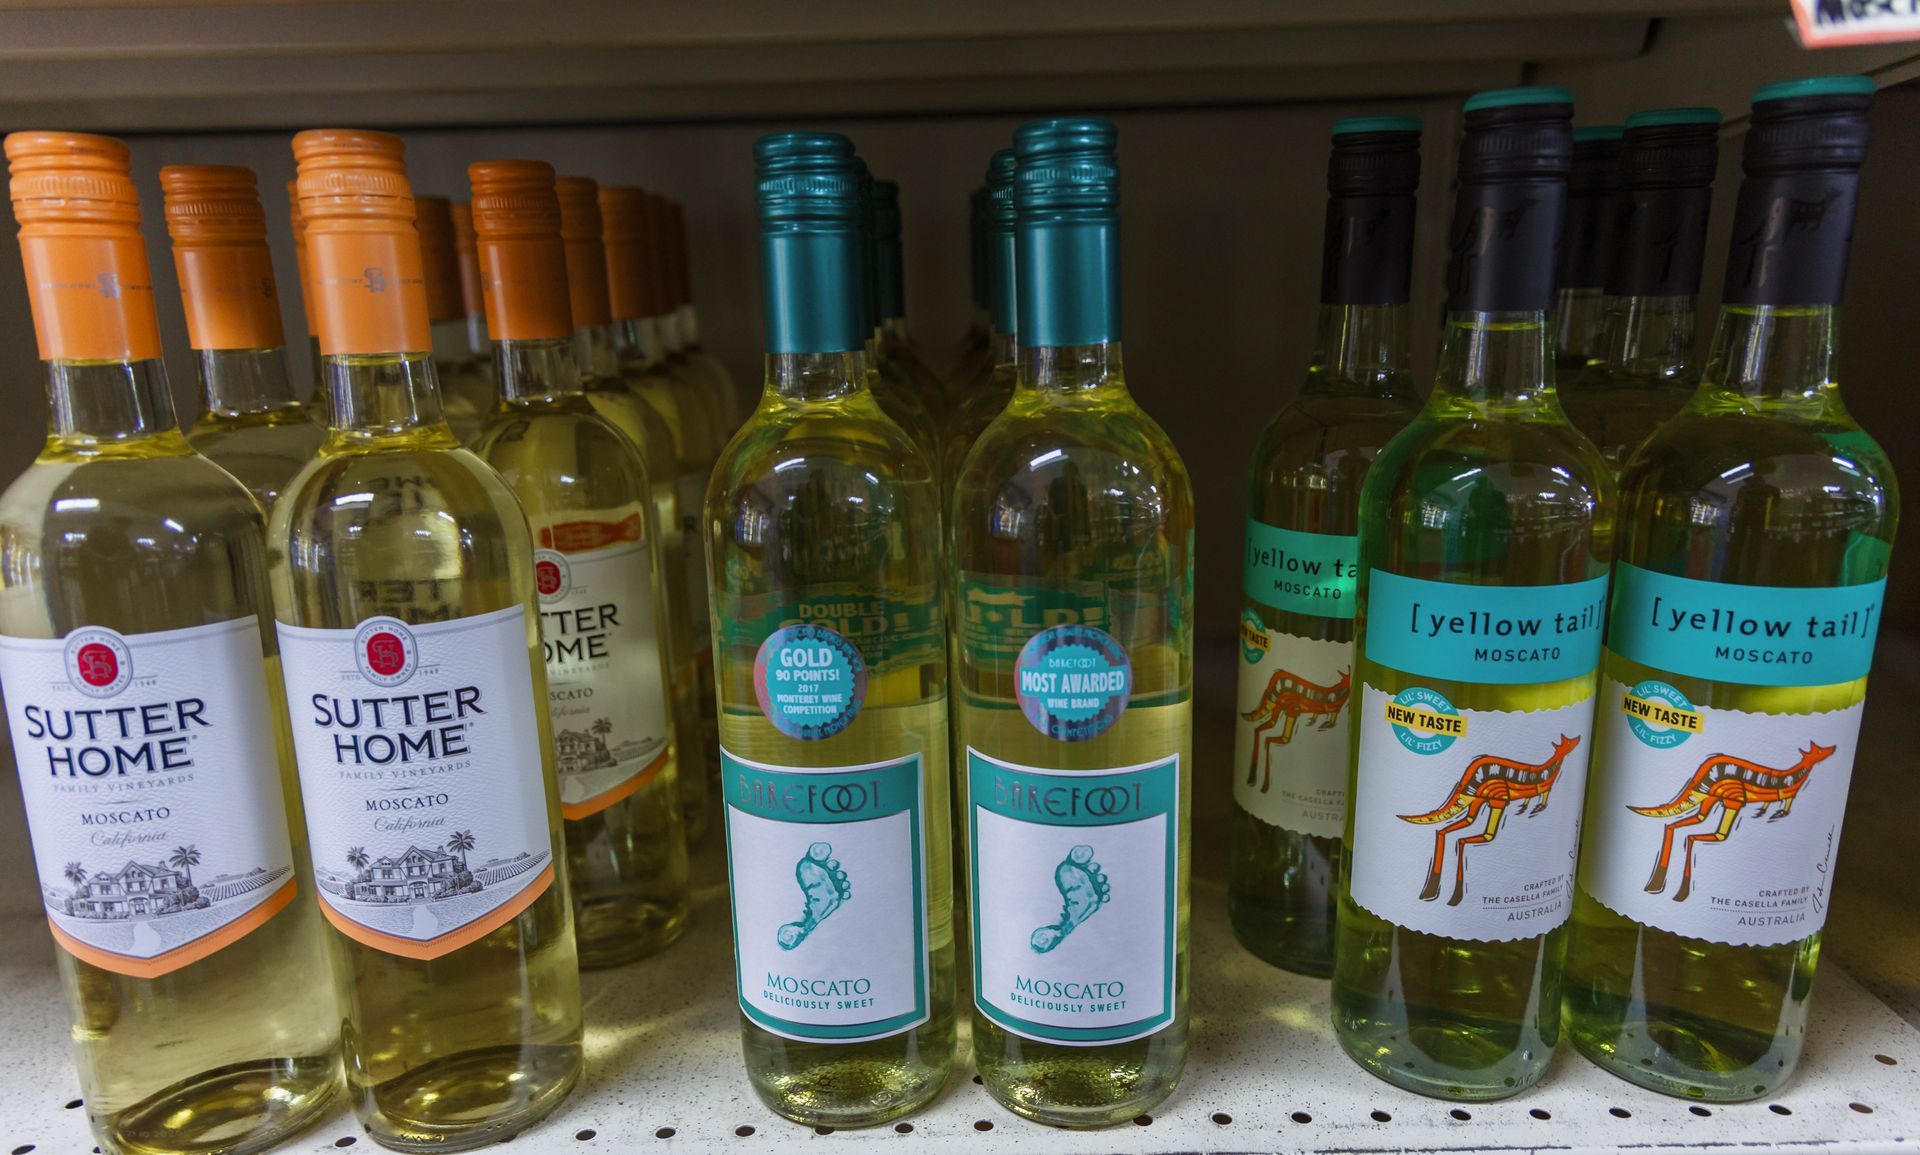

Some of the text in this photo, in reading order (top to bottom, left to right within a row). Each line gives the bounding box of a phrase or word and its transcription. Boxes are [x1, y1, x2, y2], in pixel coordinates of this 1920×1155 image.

[1273, 579, 1342, 600] MOSCATO
[780, 648, 833, 667] GOLD
[1474, 647, 1561, 663] MOSCATO
[1715, 646, 1813, 665] MOSCATO
[775, 669, 840, 681] 90 POINTS!
[1021, 670, 1124, 693] MOST AWARDED
[550, 688, 594, 701] SCATO
[777, 693, 843, 703] MONTEREY WINE
[798, 684, 819, 693] 2017
[1653, 685, 1688, 707] SWEET
[312, 686, 488, 729] SUTTER
[783, 705, 837, 715] COMPETITION
[1047, 698, 1101, 708] WINE BRAND
[1417, 691, 1452, 712] SWEET
[24, 698, 213, 741] SUTTER
[1387, 706, 1462, 733] NEW TASTE
[1624, 697, 1698, 729] NEW TASTE
[1416, 739, 1443, 751] FIZZY
[1650, 733, 1677, 745] FIZZY
[339, 760, 471, 781] FAMILY VINEYARDS
[108, 773, 196, 793] VINEYARDS
[365, 793, 450, 813] MOSCATO
[738, 774, 881, 815] BAREFOOT
[994, 775, 1144, 817] BAREFOOT
[81, 806, 171, 827] MOSCATO
[373, 815, 446, 834] California
[90, 829, 169, 848] California
[1482, 885, 1563, 904] THE CASELLA FAMILY
[1523, 877, 1557, 892] CRAFTED
[1758, 886, 1810, 898] CRAFTED BY
[1507, 901, 1562, 921] AUSTRALIA
[1710, 896, 1808, 908] THE CASELLA FAMILY
[1737, 912, 1805, 926] AUSTRALIA
[766, 972, 871, 996] MOSCATO
[1015, 975, 1125, 999] MOSCATO
[763, 990, 875, 1010] DELICIOUSLY SWEET
[1010, 992, 1128, 1013] DELICIOUSLY SWEET
